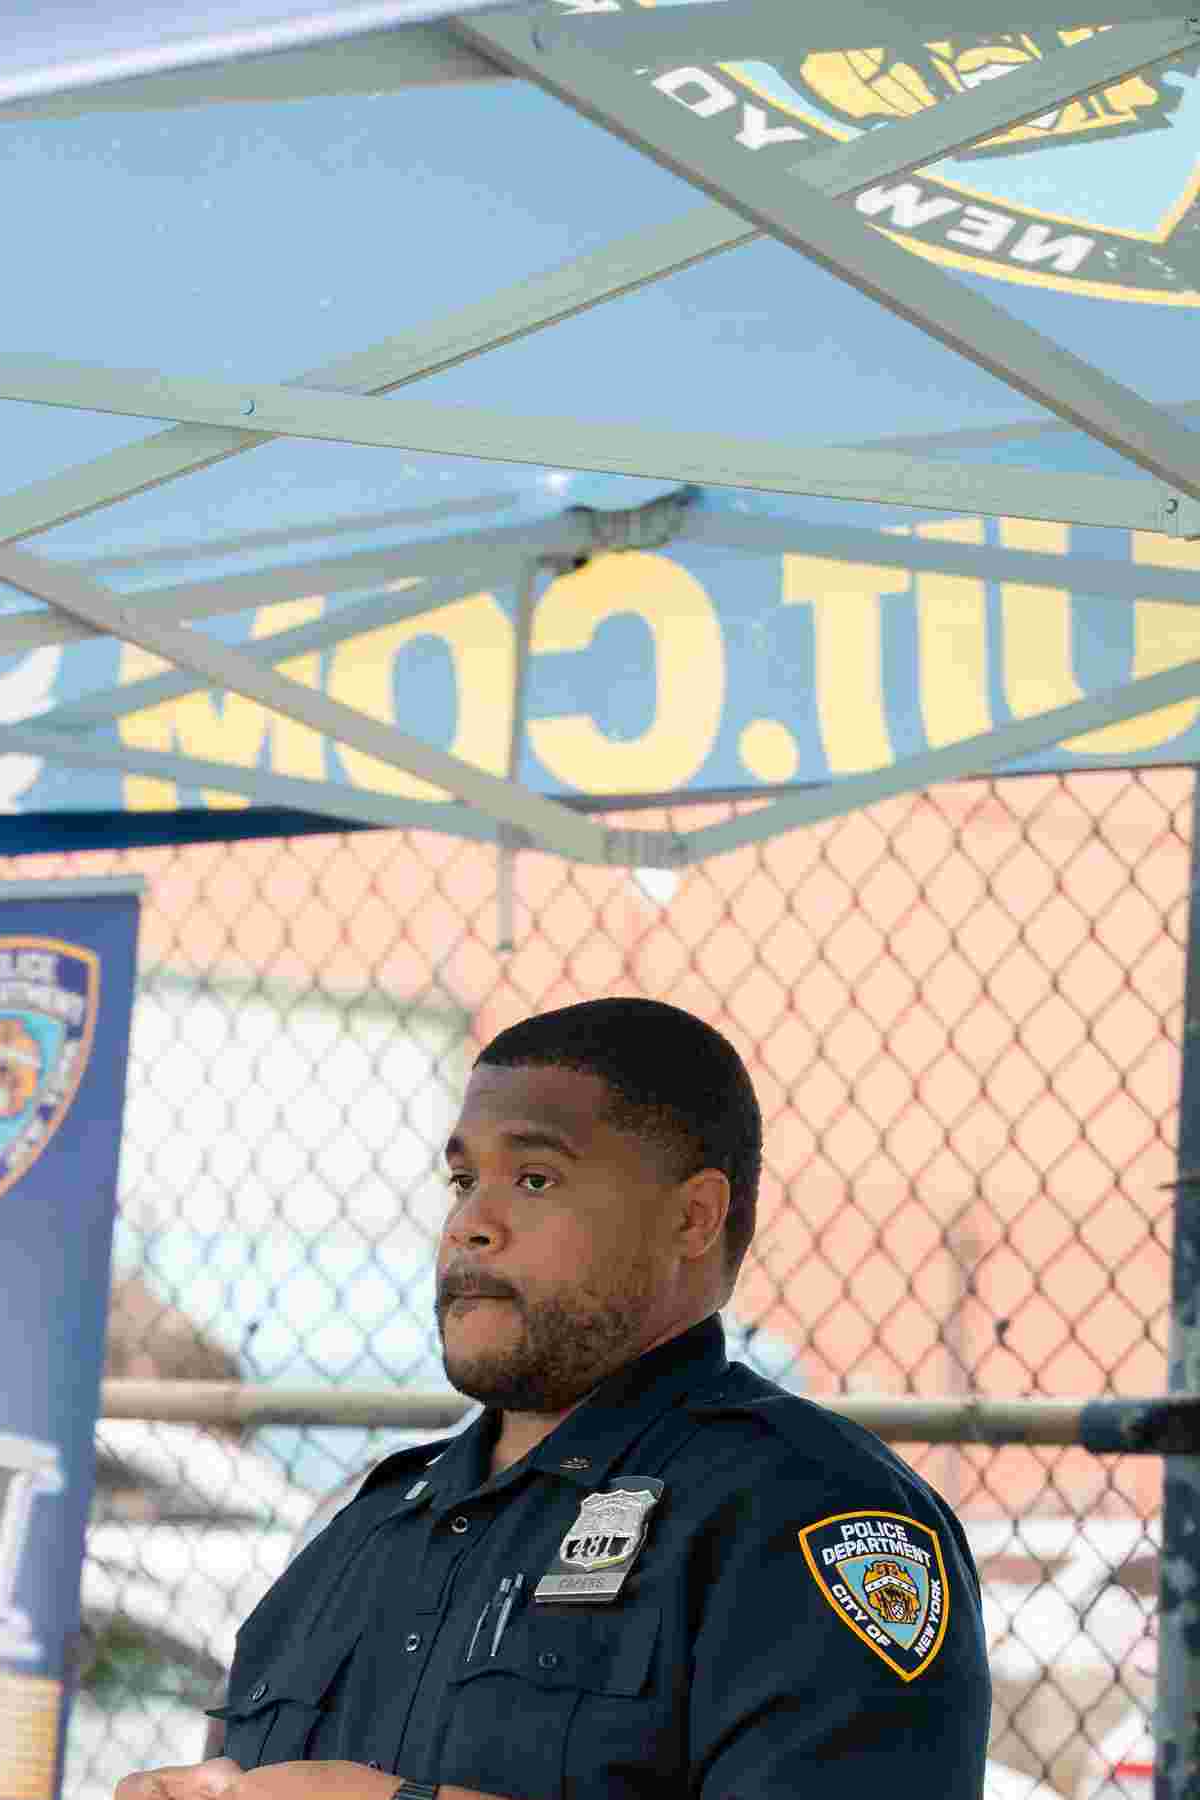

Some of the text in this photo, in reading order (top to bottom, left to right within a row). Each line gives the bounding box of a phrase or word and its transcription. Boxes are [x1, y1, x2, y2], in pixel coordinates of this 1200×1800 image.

[821, 1537, 931, 1568] DEPARTMENT
[840, 1520, 908, 1542] POLICE
[831, 1583, 892, 1648] CITY OF
[912, 1578, 942, 1658] NEW YORK
